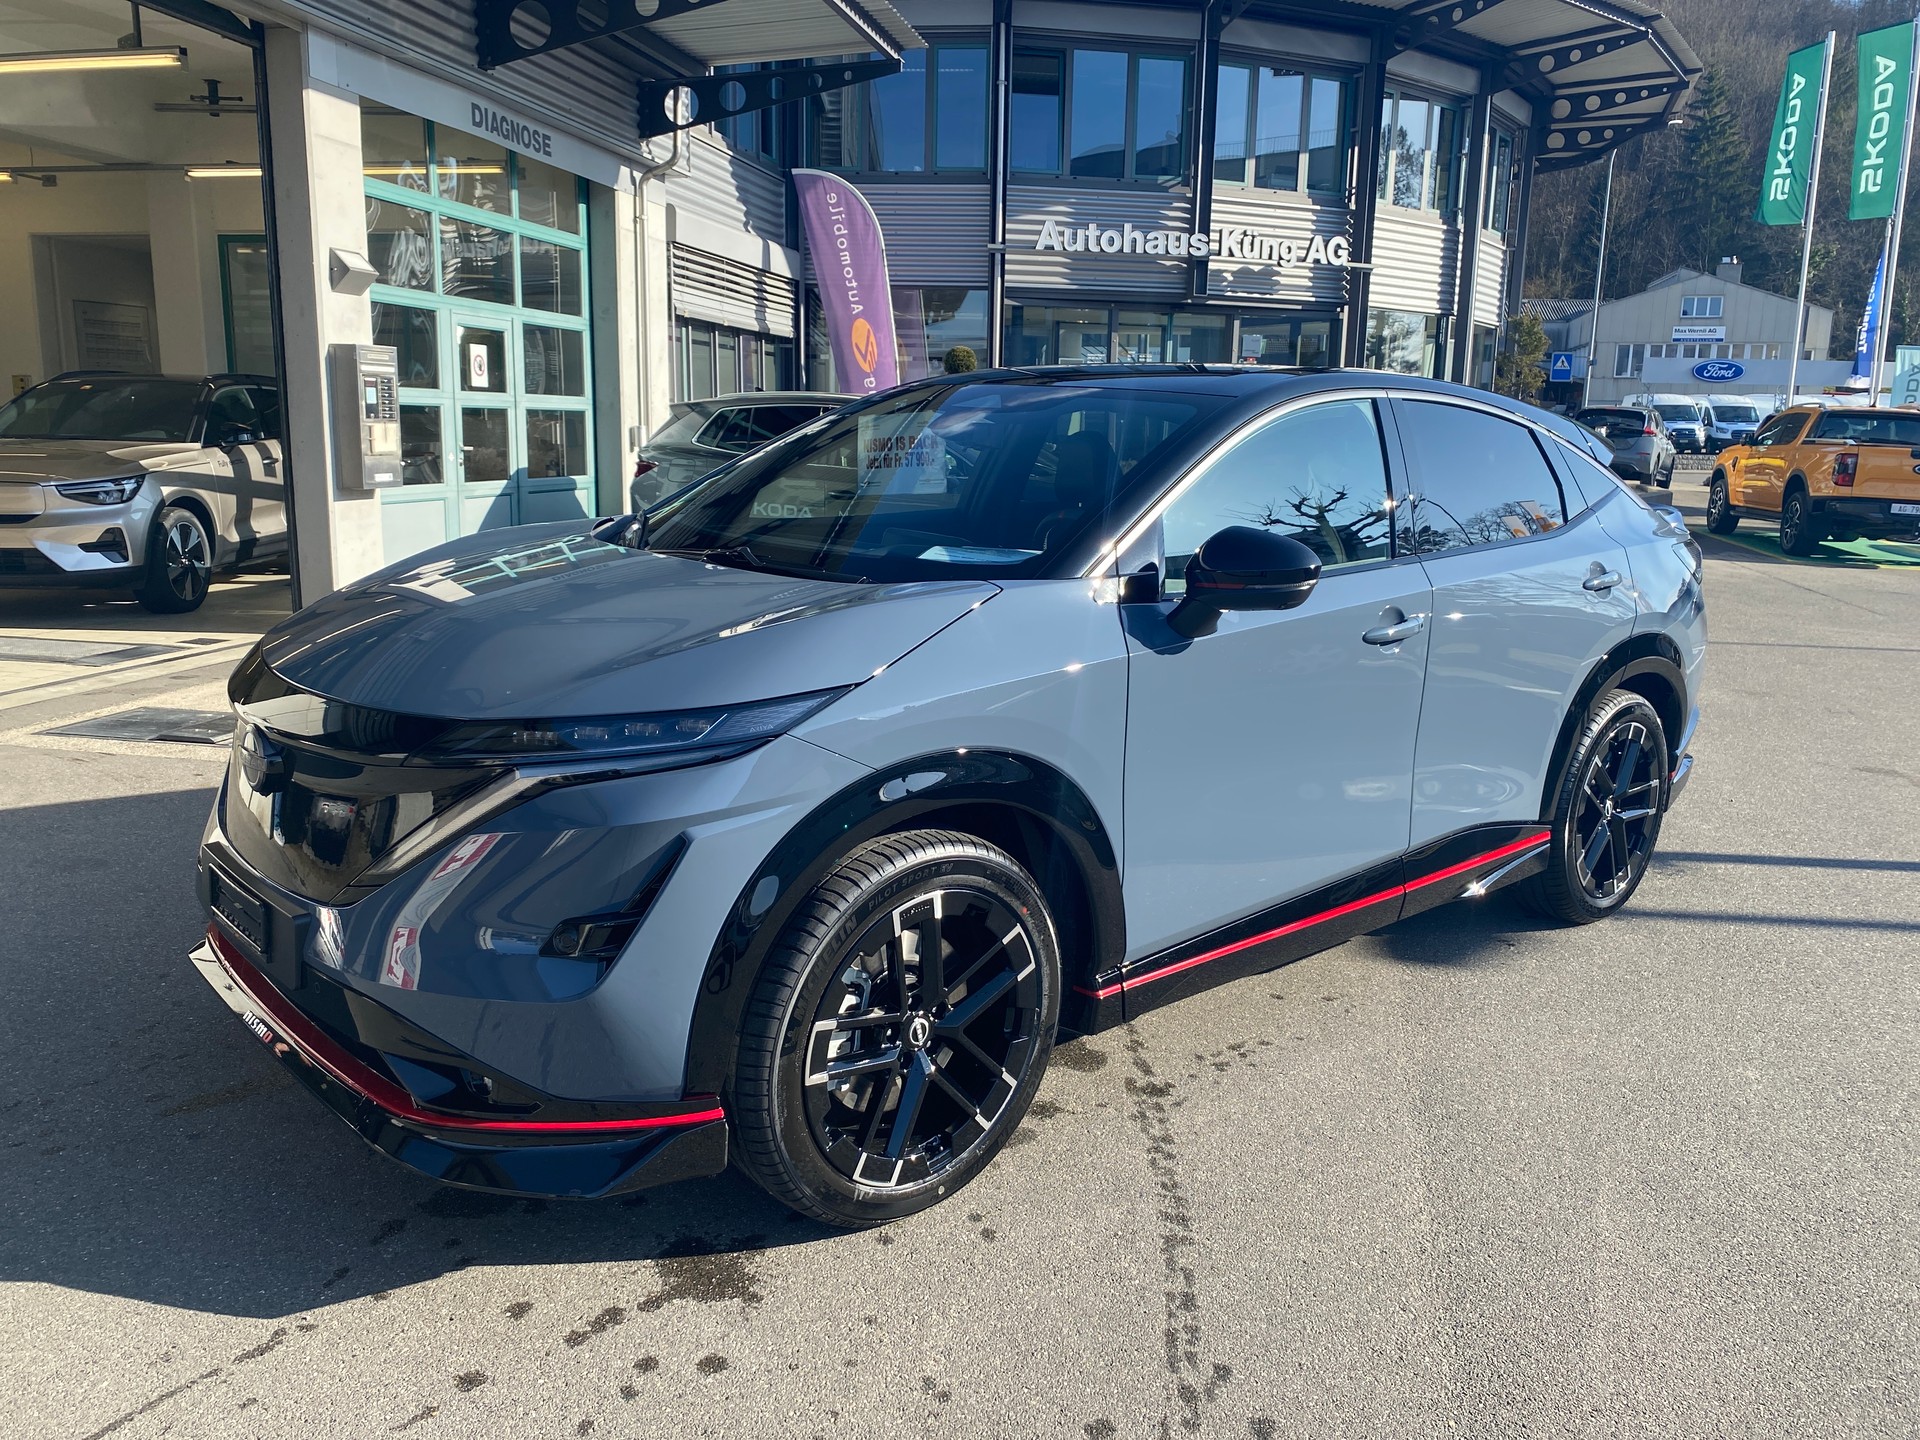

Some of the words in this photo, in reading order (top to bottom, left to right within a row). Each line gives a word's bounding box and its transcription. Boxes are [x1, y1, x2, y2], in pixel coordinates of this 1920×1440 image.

[471, 101, 553, 158] DIAGNOSE
[1035, 219, 1210, 257] Autohaus
[1221, 226, 1298, 268] Küng
[1305, 234, 1350, 266] AG
[1703, 363, 1736, 378] Ford
[864, 436, 893, 453] NISMO
[896, 435, 906, 451] IS
[883, 453, 893, 468] für
[868, 883, 898, 911] PILOT
[901, 866, 938, 887] SPORT
[795, 913, 859, 1021] MICHELIN
